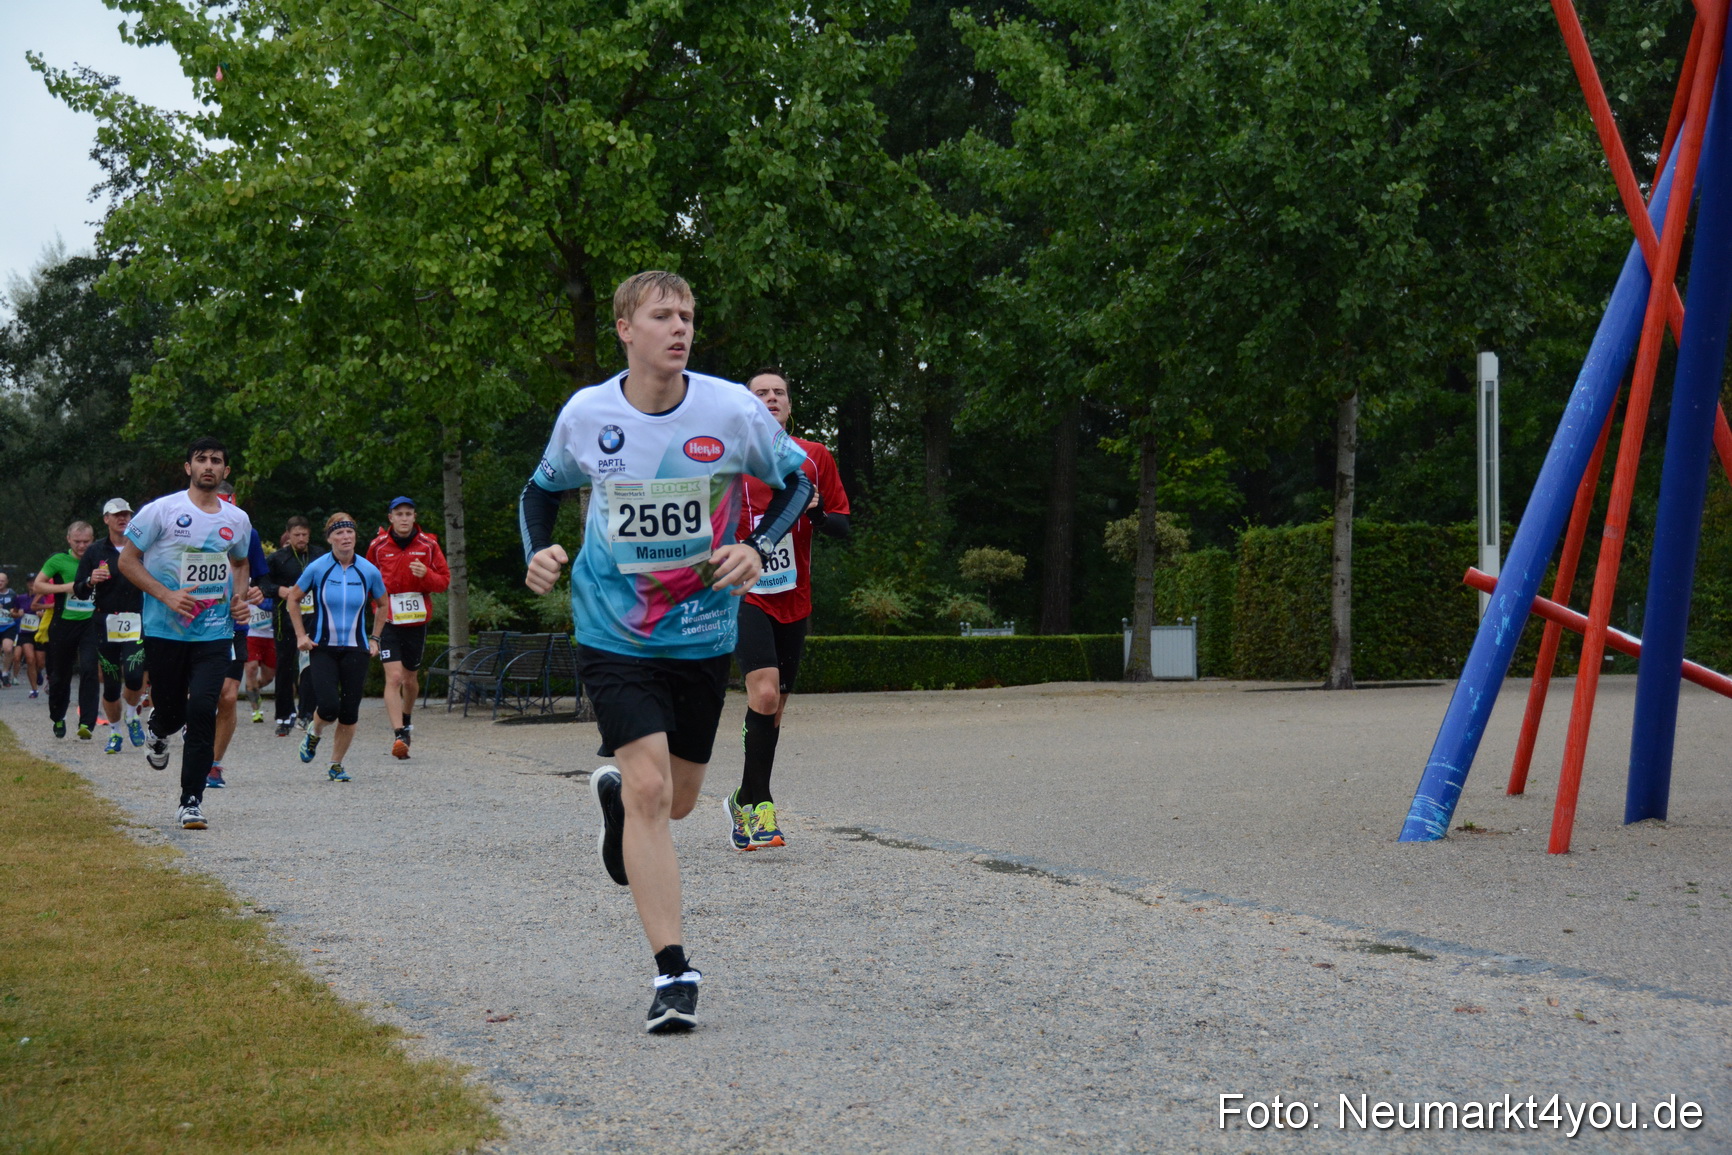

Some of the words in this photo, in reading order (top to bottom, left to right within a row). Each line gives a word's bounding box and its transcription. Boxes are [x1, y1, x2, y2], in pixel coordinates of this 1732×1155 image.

[689, 442, 721, 456] Hervis
[598, 458, 626, 468] PARTL
[651, 481, 701, 495] BOCK
[618, 500, 702, 538] 2569
[636, 544, 687, 560] Manuel
[186, 563, 228, 582] 2803
[190, 585, 224, 595] amidullah
[398, 599, 420, 611] 159
[680, 599, 704, 615] 17.
[681, 608, 727, 625] Neumarkter
[117, 620, 131, 632] 73
[681, 619, 721, 636] Stadtlauf
